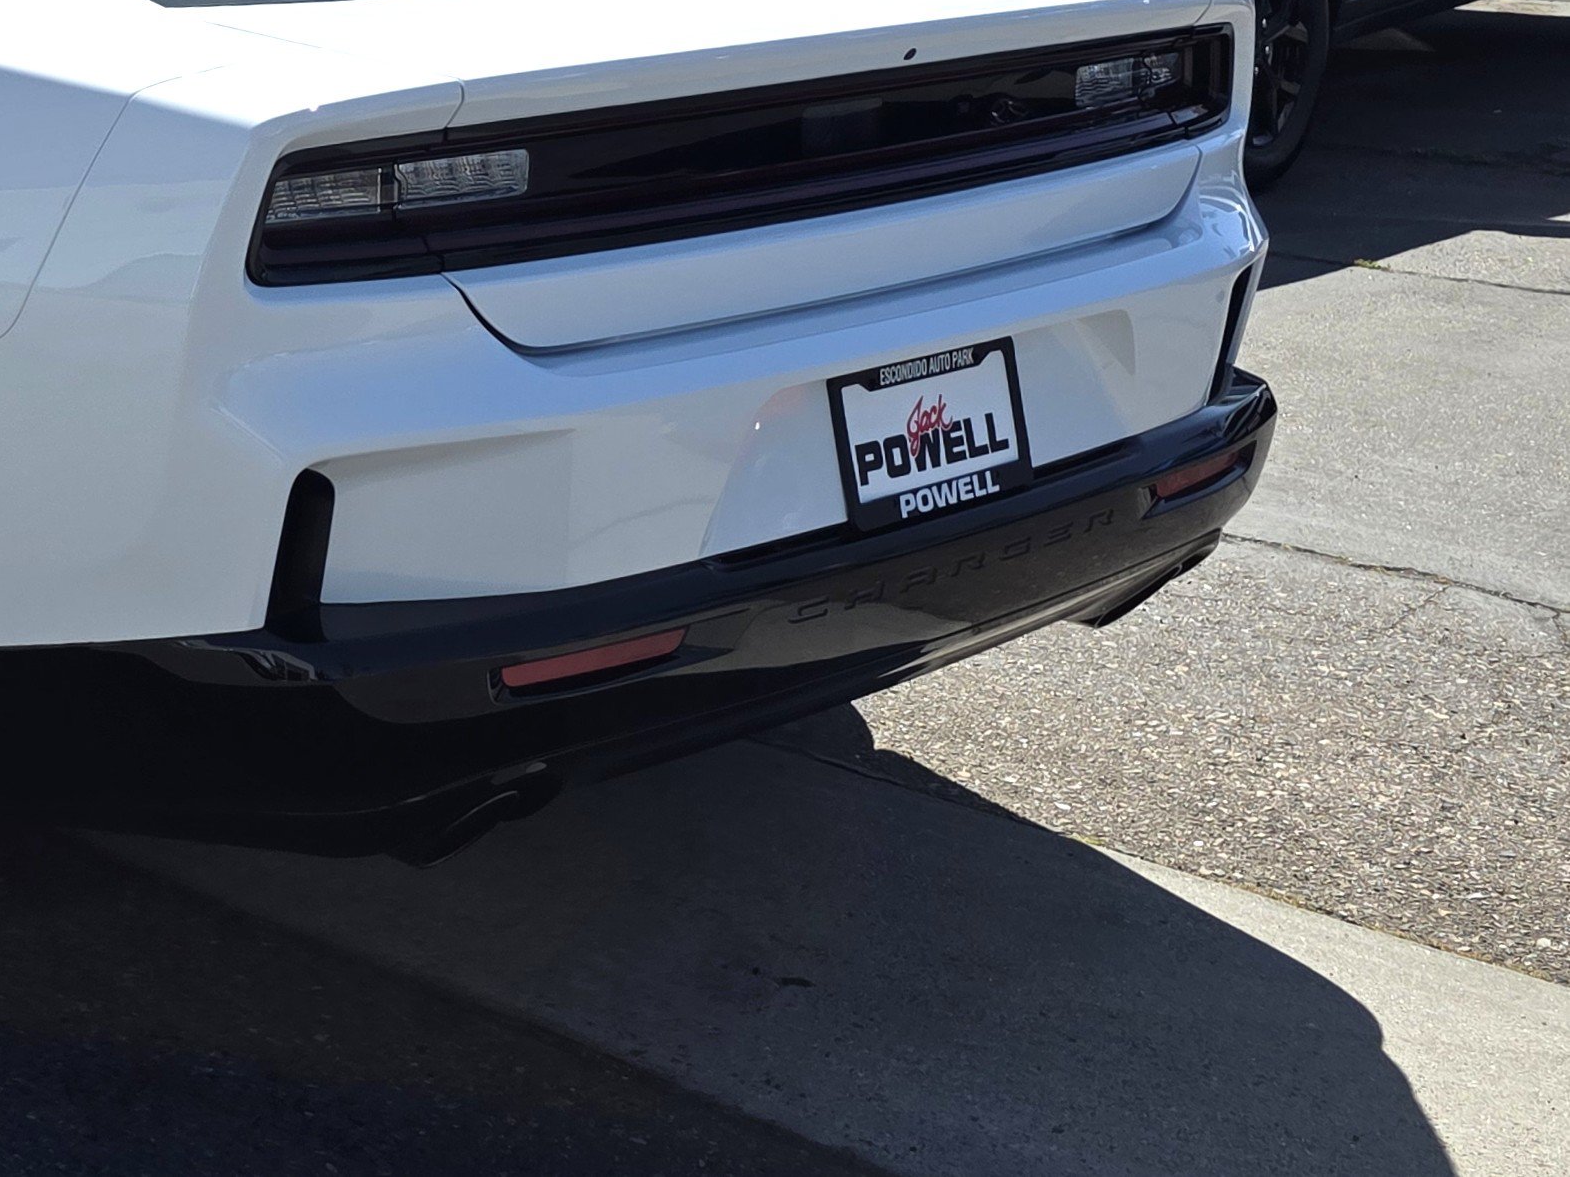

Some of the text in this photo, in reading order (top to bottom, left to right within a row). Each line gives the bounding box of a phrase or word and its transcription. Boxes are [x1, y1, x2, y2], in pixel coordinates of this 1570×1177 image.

[880, 347, 974, 385] ESCONDIDO AUTO PARK
[855, 412, 1010, 487] POWELL
[906, 393, 953, 458] Jack
[899, 470, 1001, 519] POWELL
